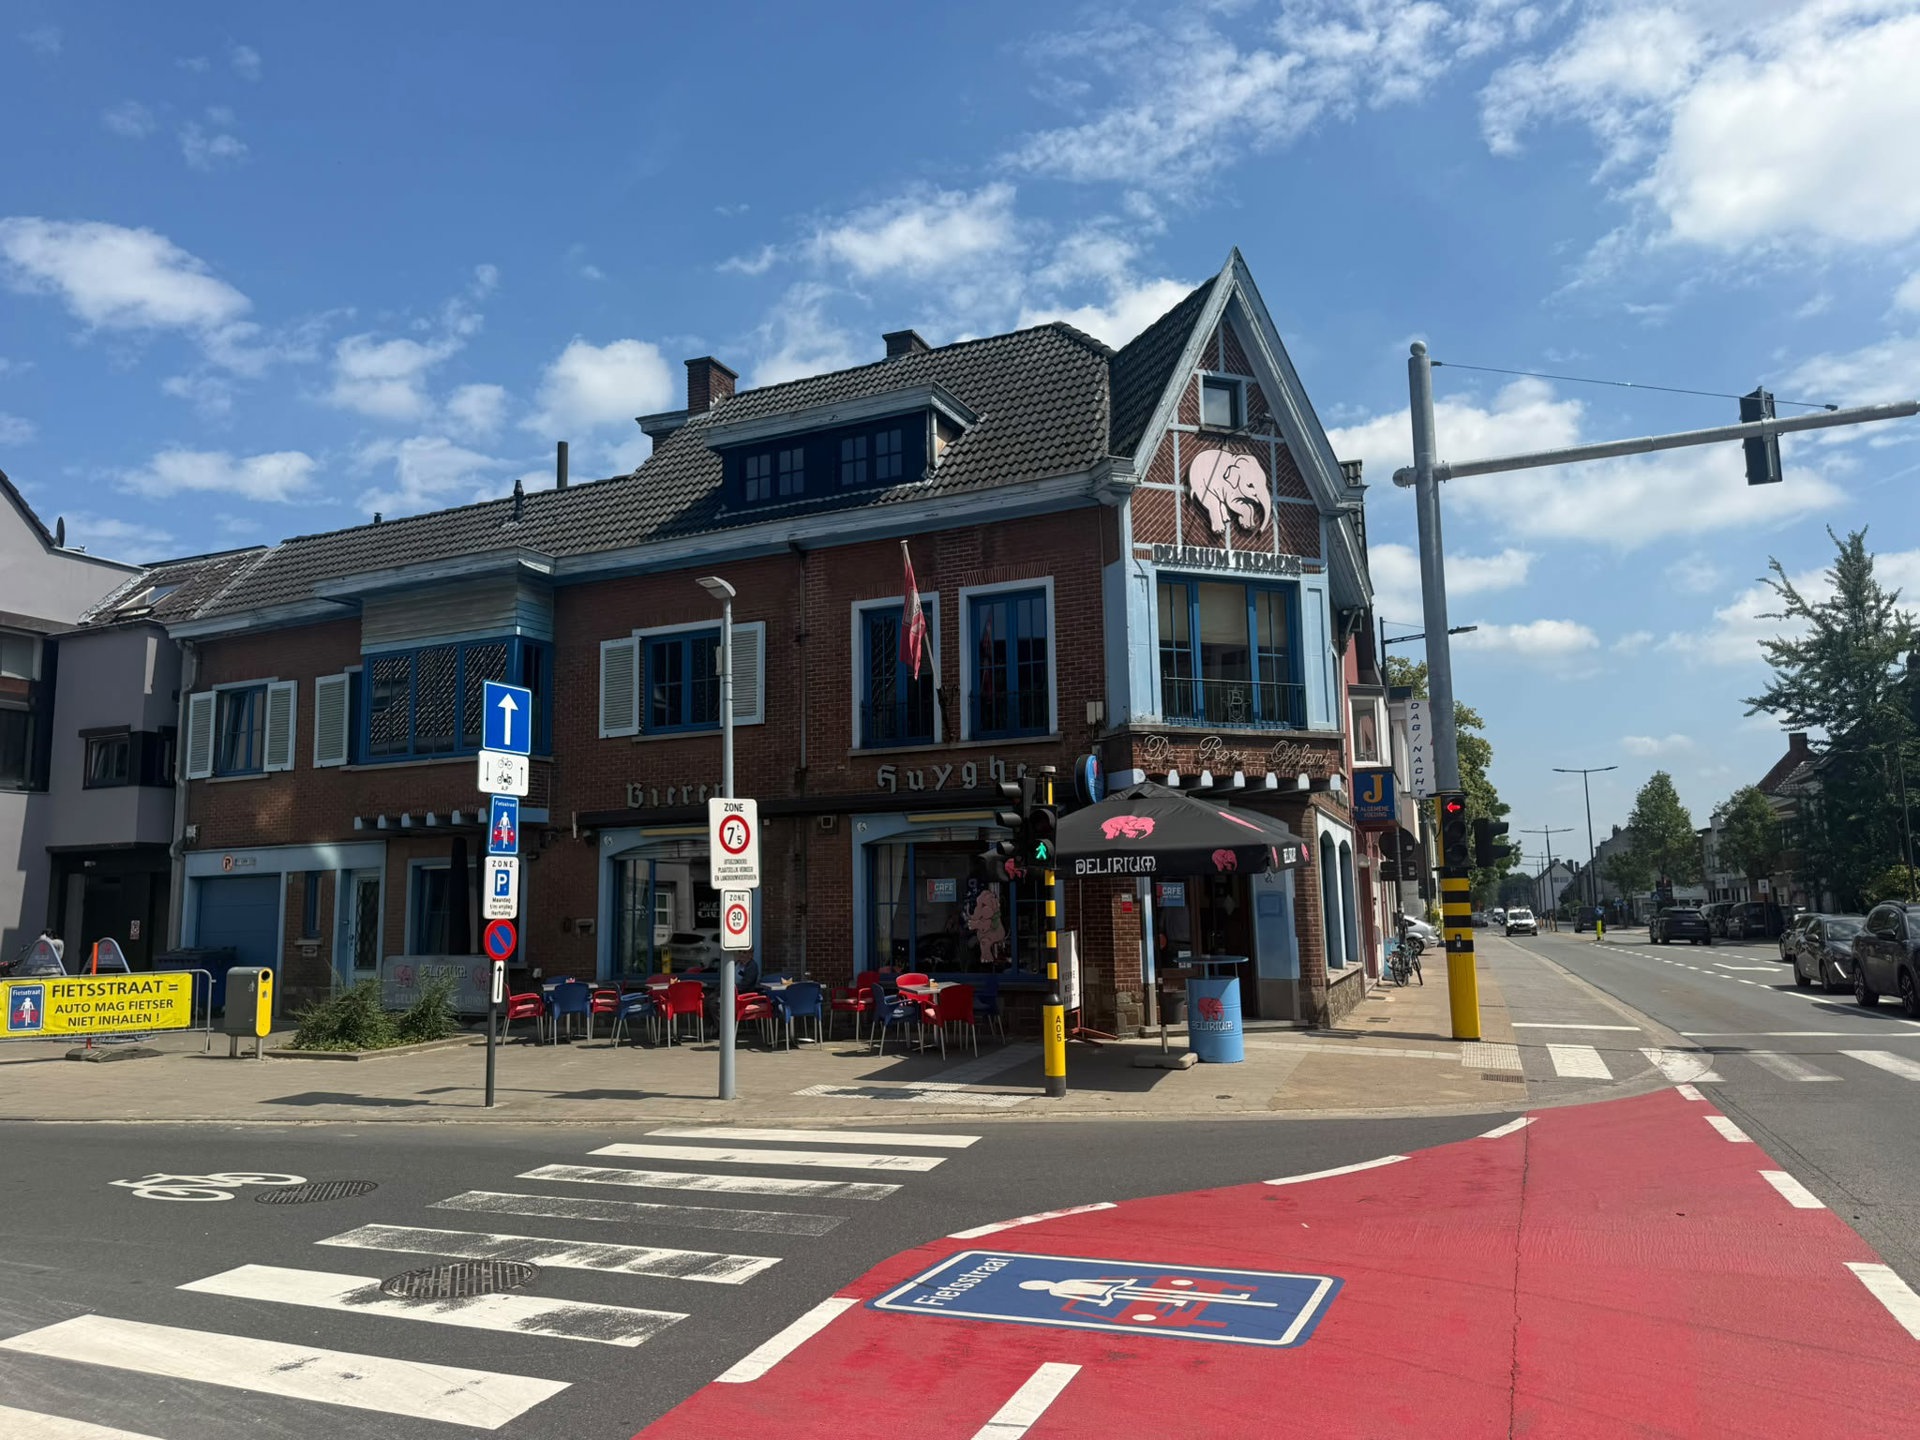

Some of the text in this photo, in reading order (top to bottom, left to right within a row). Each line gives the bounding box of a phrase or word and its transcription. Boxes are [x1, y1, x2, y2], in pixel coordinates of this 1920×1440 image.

[1153, 544, 1301, 572] DELIRIUM TREMENS
[1144, 734, 1175, 760] De
[1199, 736, 1248, 762] Roze
[1363, 774, 1384, 803] J
[724, 803, 744, 812] ZONE
[492, 860, 513, 868] ZONE
[1075, 856, 1157, 875] DELIRIUM
[497, 873, 508, 892] P
[731, 911, 742, 921] 30
[12, 988, 41, 996] Fietsstraat
[52, 981, 164, 998] FIETSSTRAAT
[55, 999, 174, 1014] AUTO MAG FIETSER
[68, 1016, 95, 1027] NIET
[99, 1013, 152, 1025] INHALEN
[913, 1257, 1014, 1306] Fietsstraat
